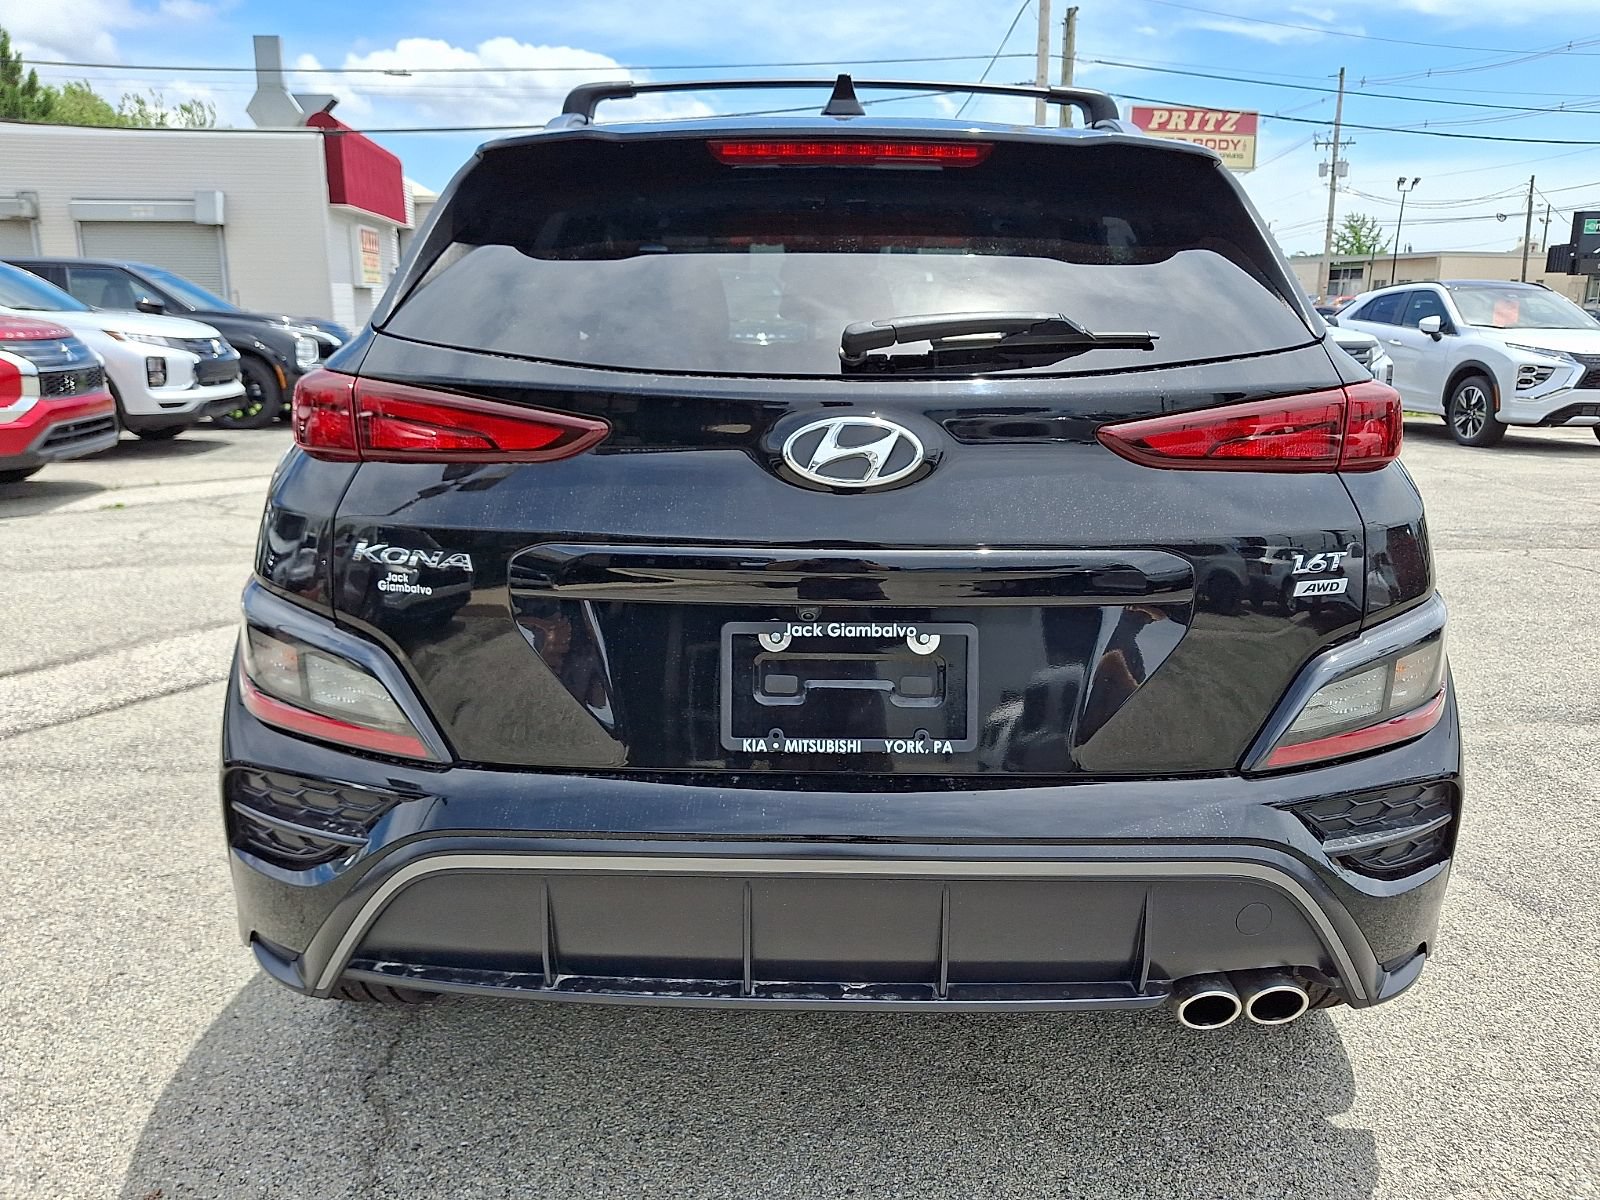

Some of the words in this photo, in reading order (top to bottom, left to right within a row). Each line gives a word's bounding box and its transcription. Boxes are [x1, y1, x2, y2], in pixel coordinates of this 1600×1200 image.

[1148, 109, 1241, 132] PRITZ
[352, 539, 473, 572] KONA
[385, 572, 408, 583] Jack
[377, 580, 433, 595] Giambalvo
[1302, 582, 1340, 593] AWD
[784, 623, 823, 637] Jack
[827, 623, 917, 638] Giambalvo
[743, 739, 767, 753] KIA
[785, 740, 862, 753] MITSUBISHI
[884, 740, 929, 754] YORK,
[934, 741, 953, 753] PA
